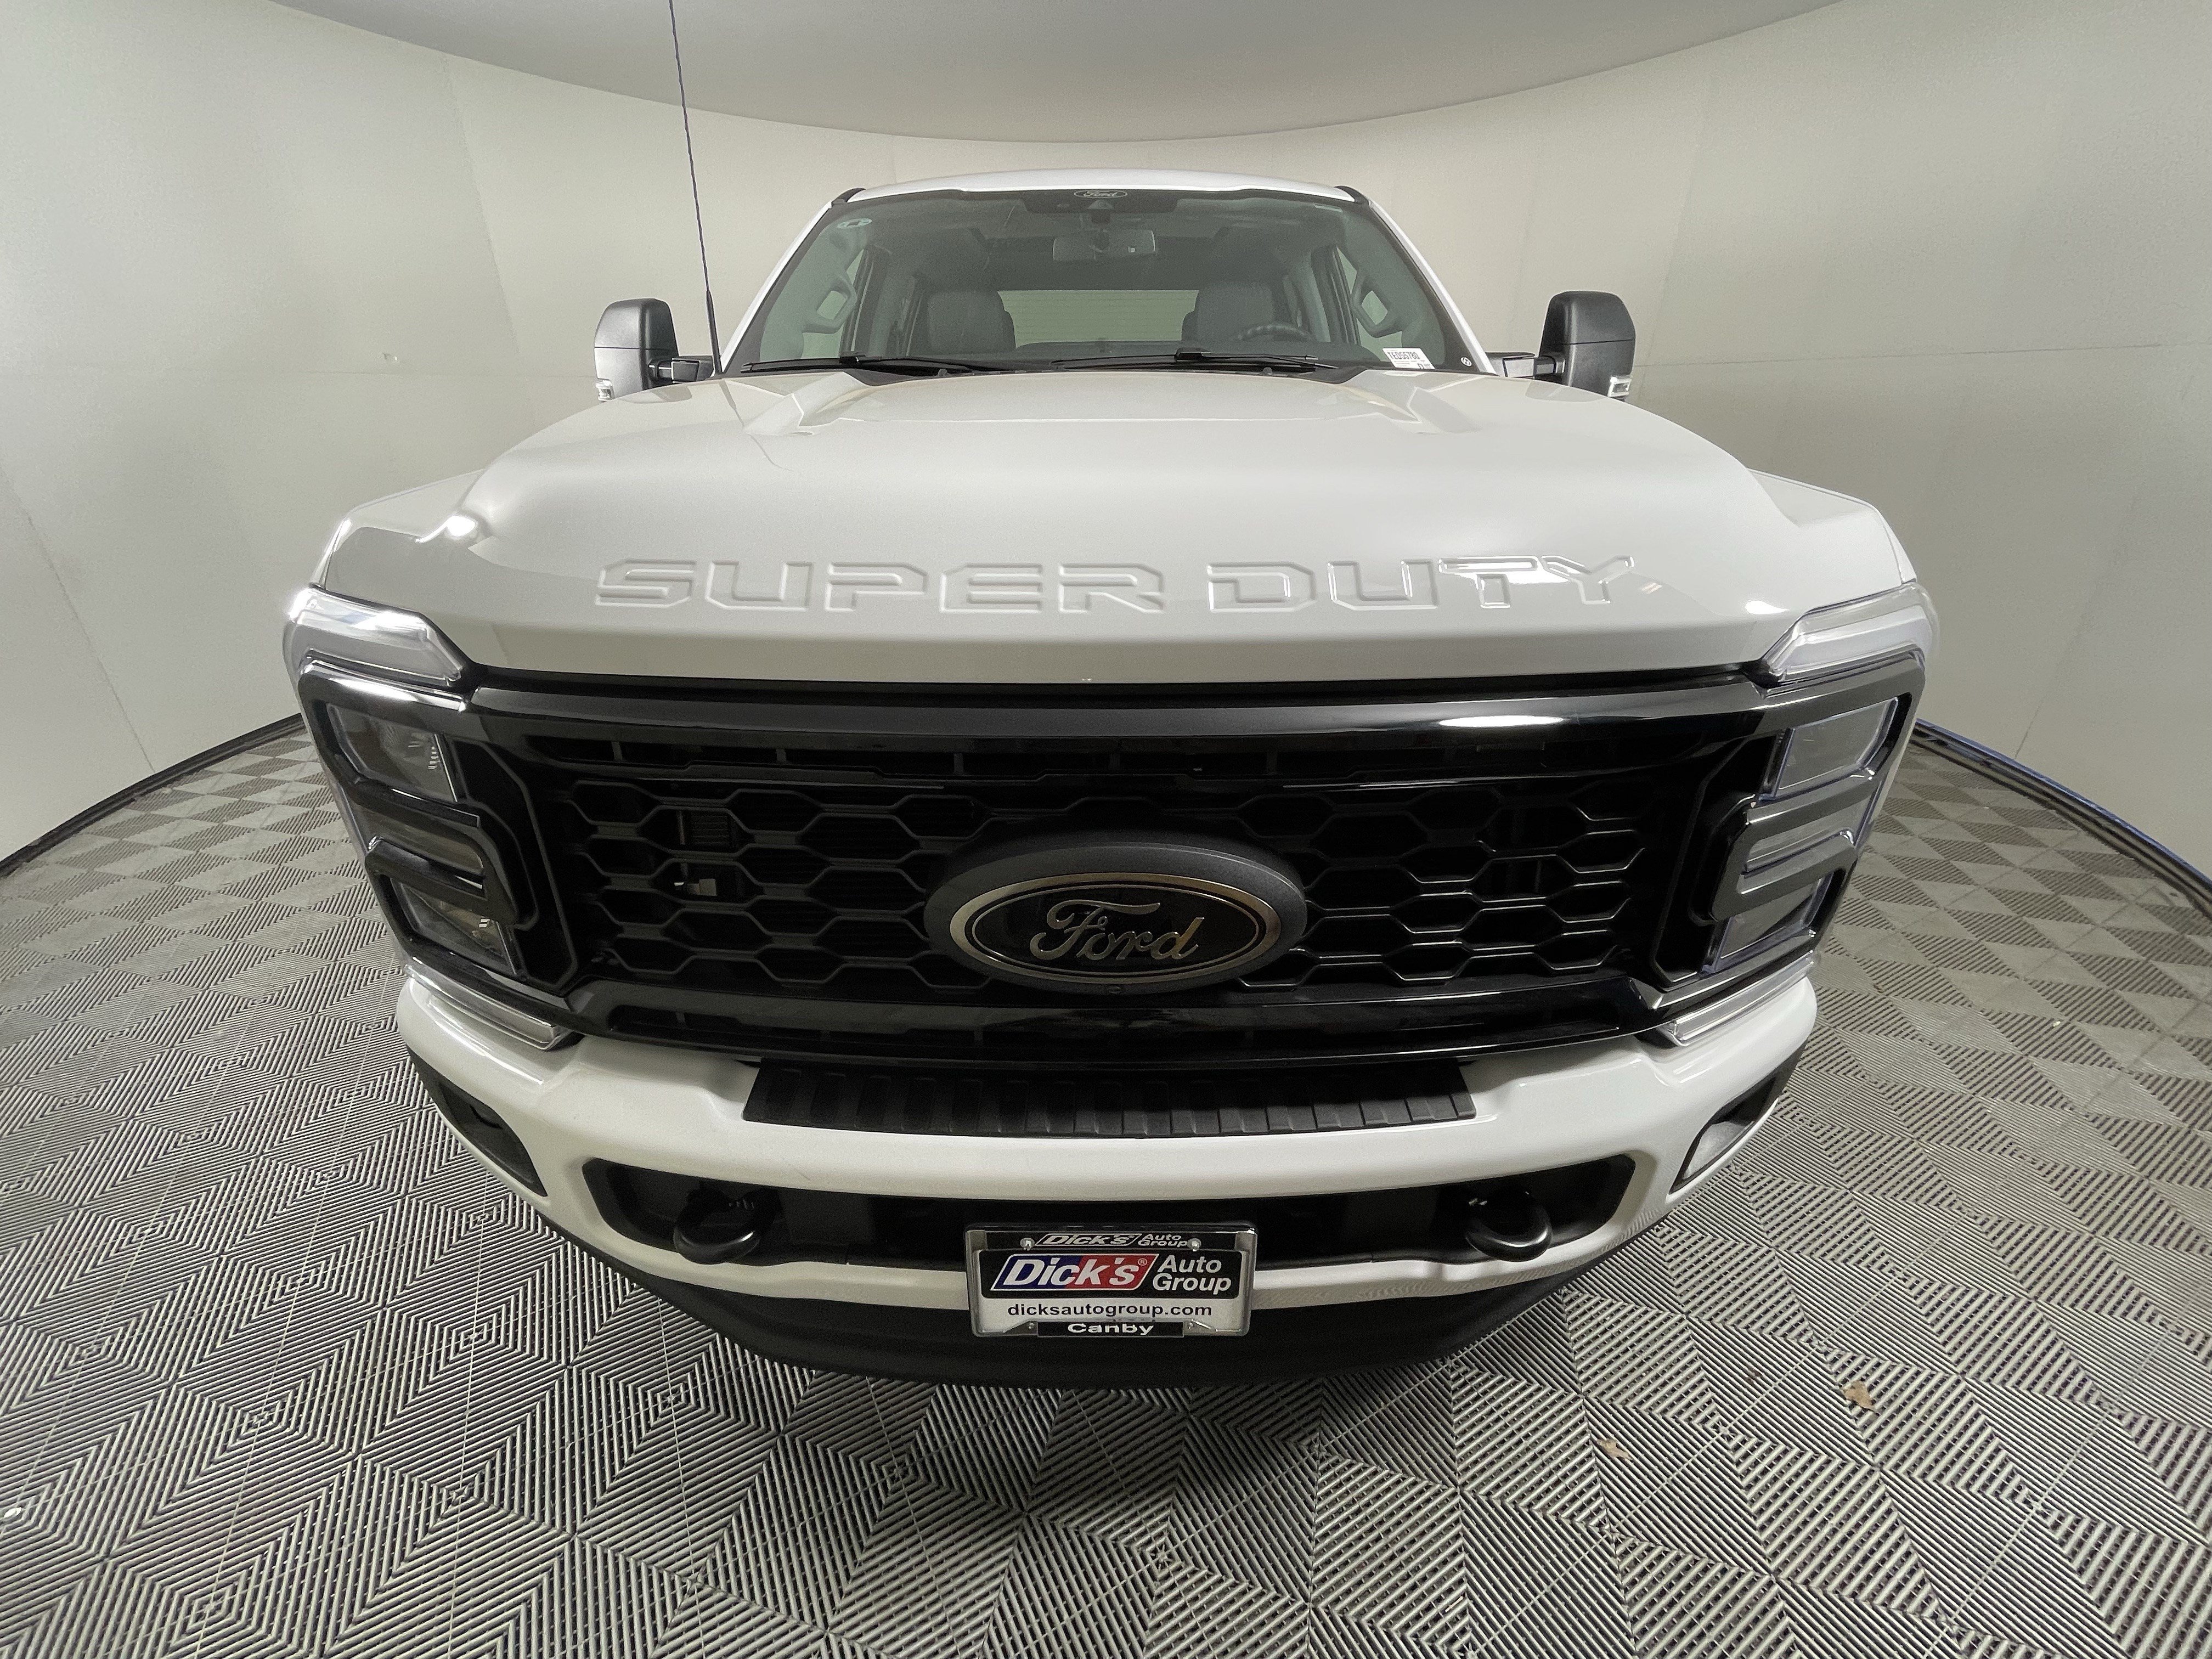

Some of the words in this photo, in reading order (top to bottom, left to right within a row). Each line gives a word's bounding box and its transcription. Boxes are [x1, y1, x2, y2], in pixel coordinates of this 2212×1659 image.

[595, 558, 1165, 613] SUPER
[1207, 555, 1635, 613] DUTY
[1029, 899, 1205, 961] Ford
[1042, 1234, 1130, 1245] Dick's
[1137, 1239, 1188, 1248] Group
[1003, 1257, 1139, 1286] Dick's
[1157, 1254, 1222, 1273] Auto
[1153, 1273, 1232, 1295] Group
[1007, 1304, 1212, 1317] dicksautogroup.com
[1068, 1323, 1154, 1336] Canby
